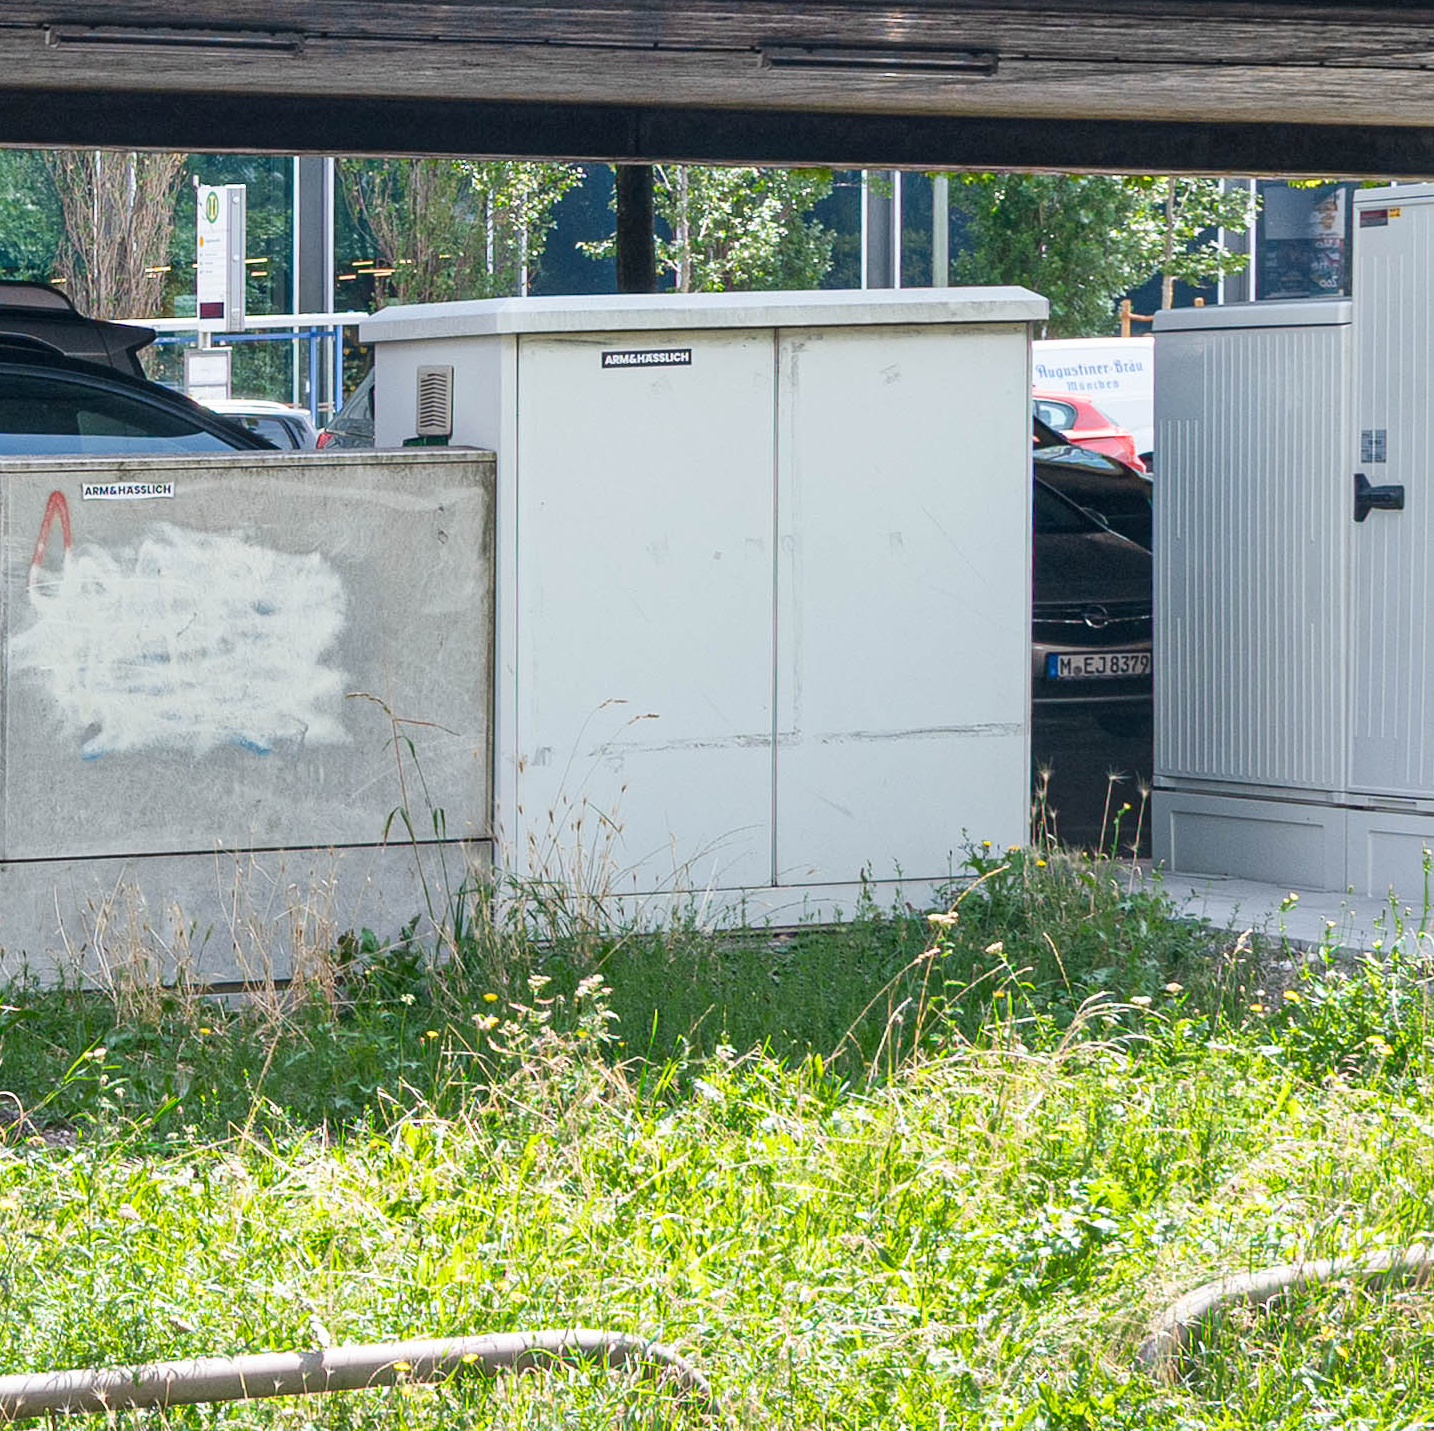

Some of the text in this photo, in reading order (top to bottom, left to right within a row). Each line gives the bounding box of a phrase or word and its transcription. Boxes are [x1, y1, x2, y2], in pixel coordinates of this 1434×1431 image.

[1059, 654, 1150, 675] M EJ 8379
